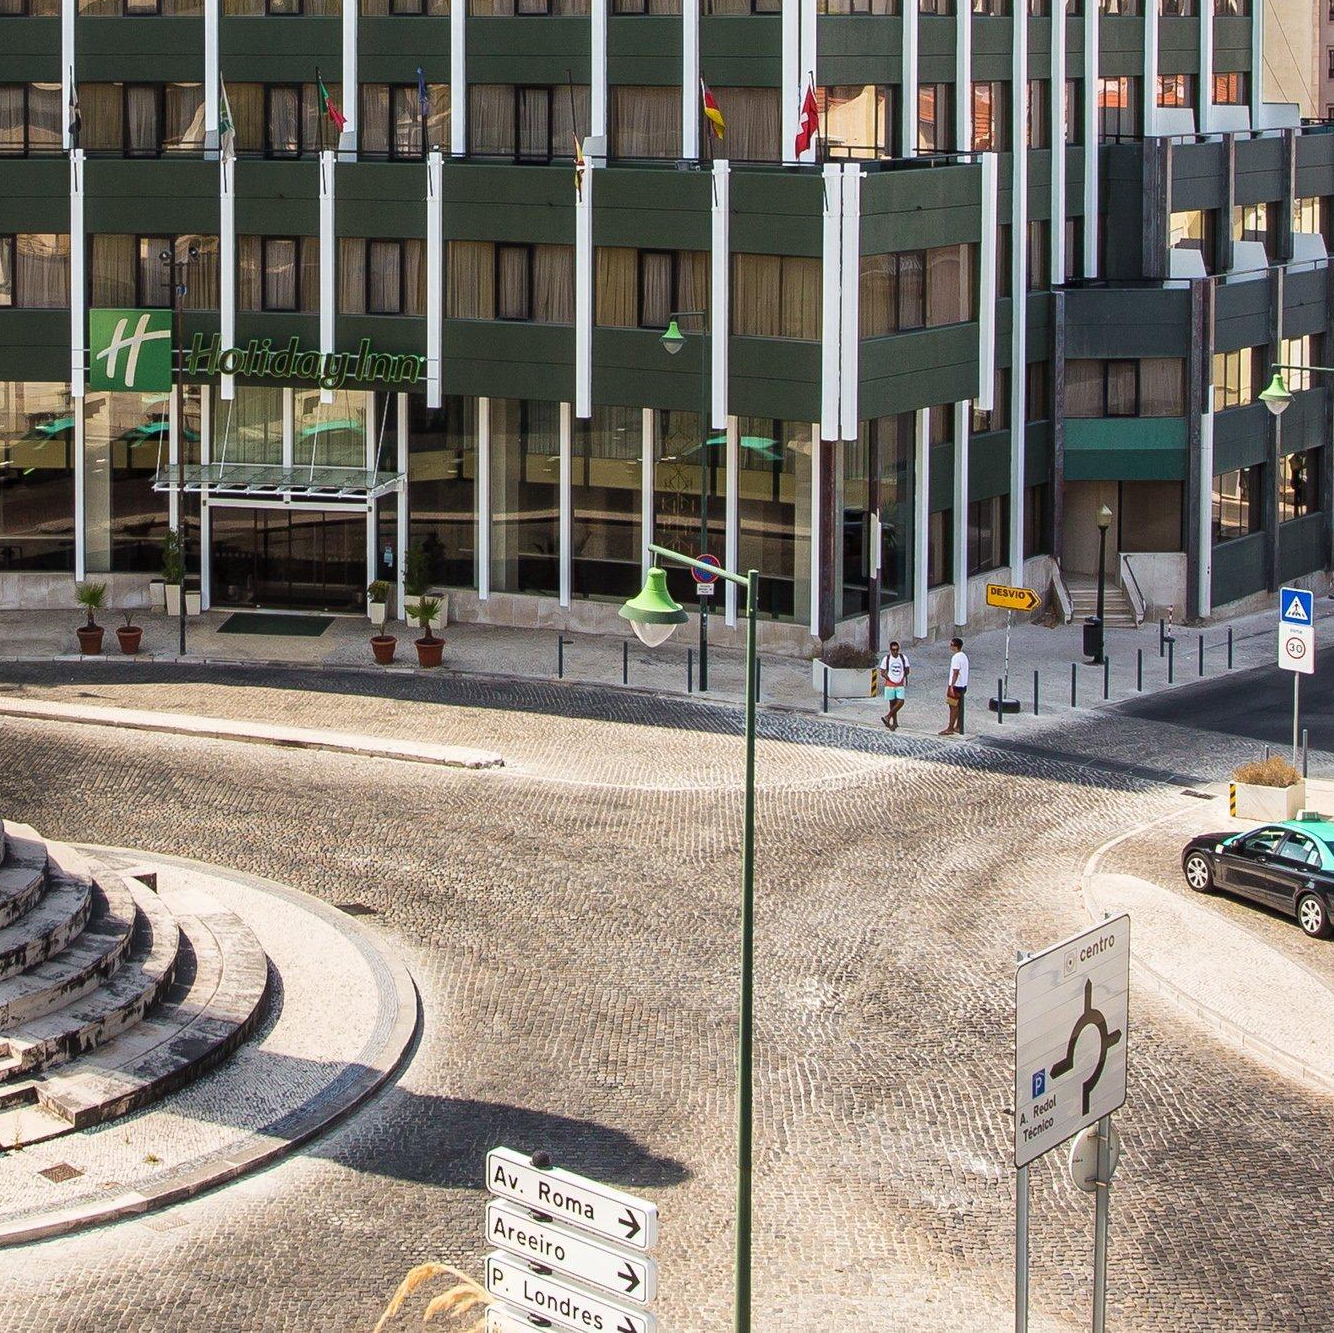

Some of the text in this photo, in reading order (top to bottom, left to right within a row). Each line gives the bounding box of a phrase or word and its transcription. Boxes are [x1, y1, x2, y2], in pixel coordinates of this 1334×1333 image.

[186, 331, 348, 391] Holiday
[354, 337, 423, 384] Inn
[990, 587, 1026, 600] DESVIO
[1288, 642, 1303, 653] 30
[1079, 933, 1116, 963] centro
[1034, 1076, 1043, 1096] P
[1019, 1094, 1057, 1128] A. Redol
[1022, 1117, 1055, 1144] Técnico
[493, 1165, 595, 1221] Av. Roma
[493, 1217, 566, 1262] Areeiro
[492, 1267, 604, 1331] P. Londres
